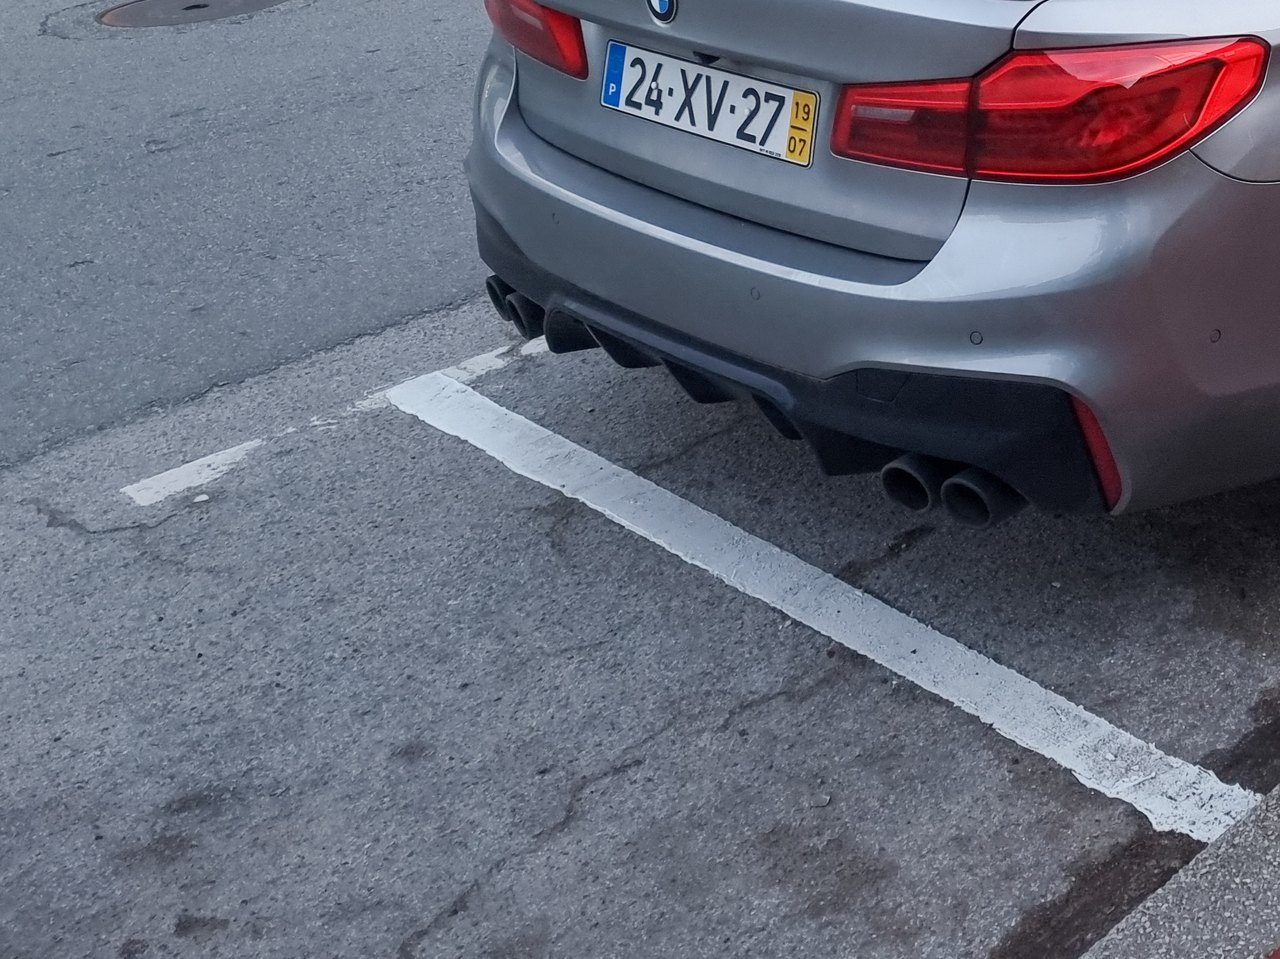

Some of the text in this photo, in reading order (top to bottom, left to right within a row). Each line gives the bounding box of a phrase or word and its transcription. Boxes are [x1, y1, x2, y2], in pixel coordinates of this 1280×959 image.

[608, 82, 617, 96] P
[794, 101, 811, 122] 19
[787, 135, 807, 157] 07
